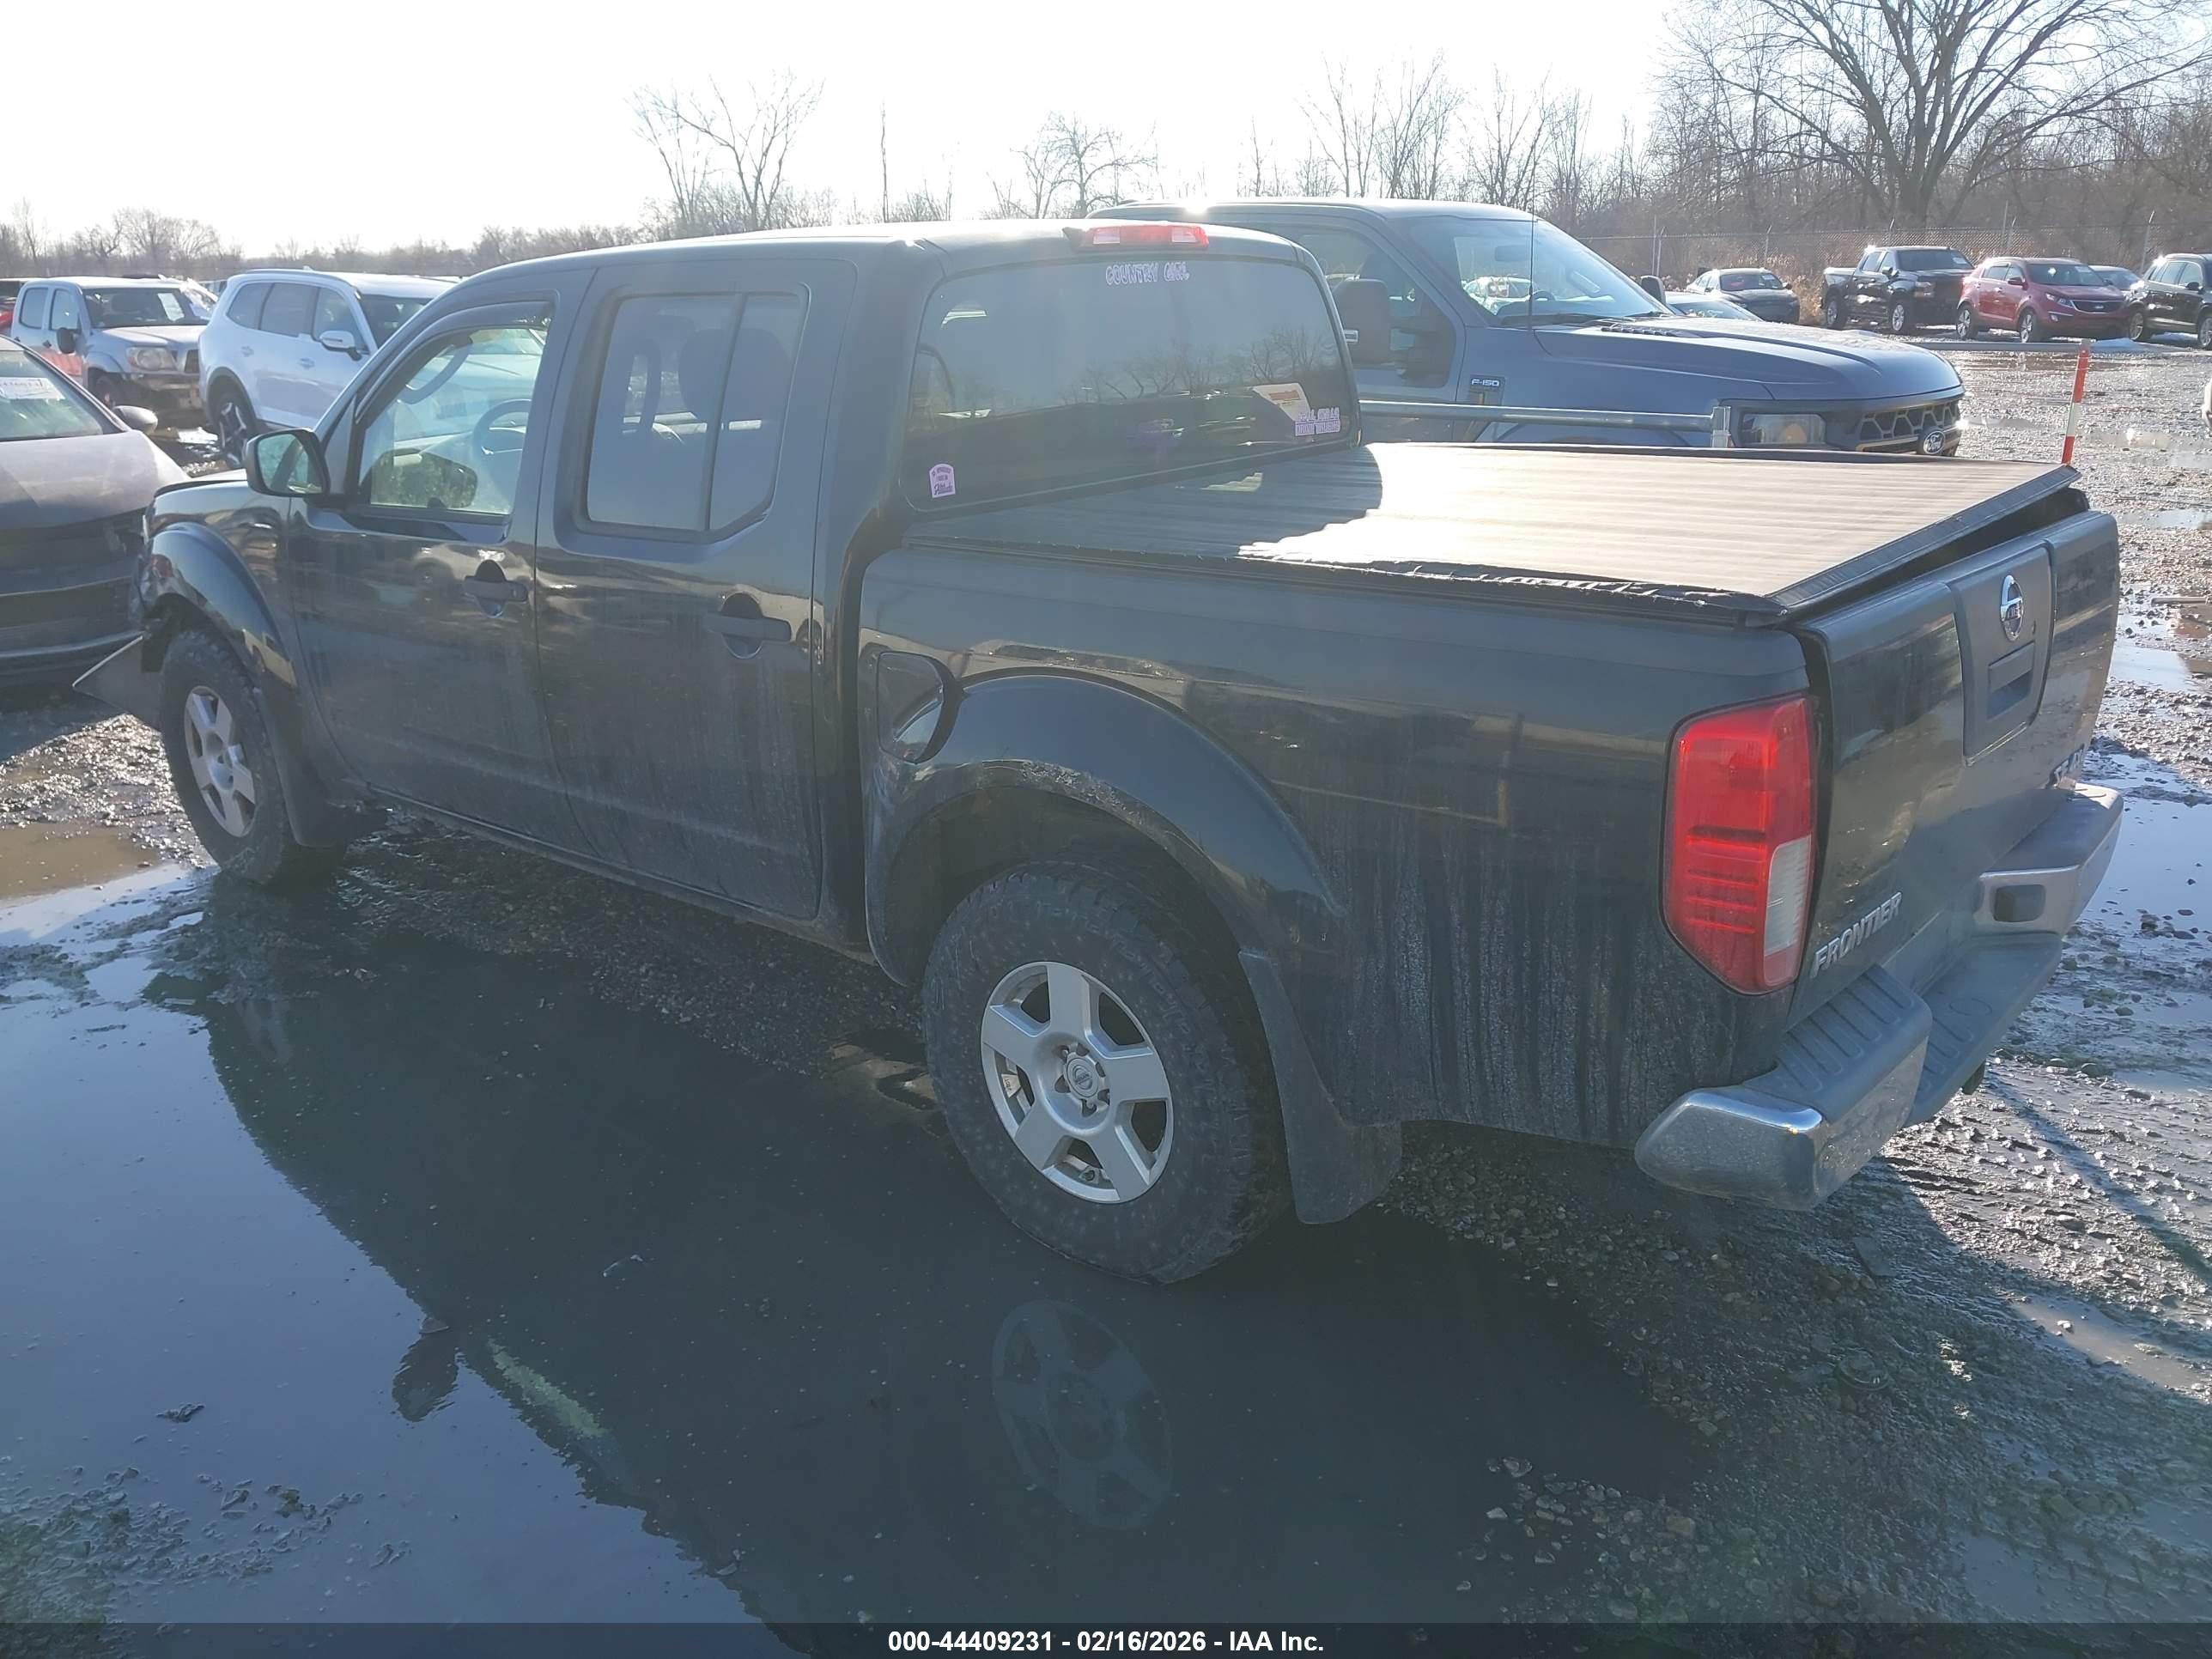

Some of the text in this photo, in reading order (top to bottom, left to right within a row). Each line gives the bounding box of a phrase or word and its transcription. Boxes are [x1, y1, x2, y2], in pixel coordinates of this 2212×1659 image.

[1105, 262, 1159, 285] COUNTRY
[1471, 378, 1500, 387] F-150
[1809, 891, 1903, 979] FRONTIER
